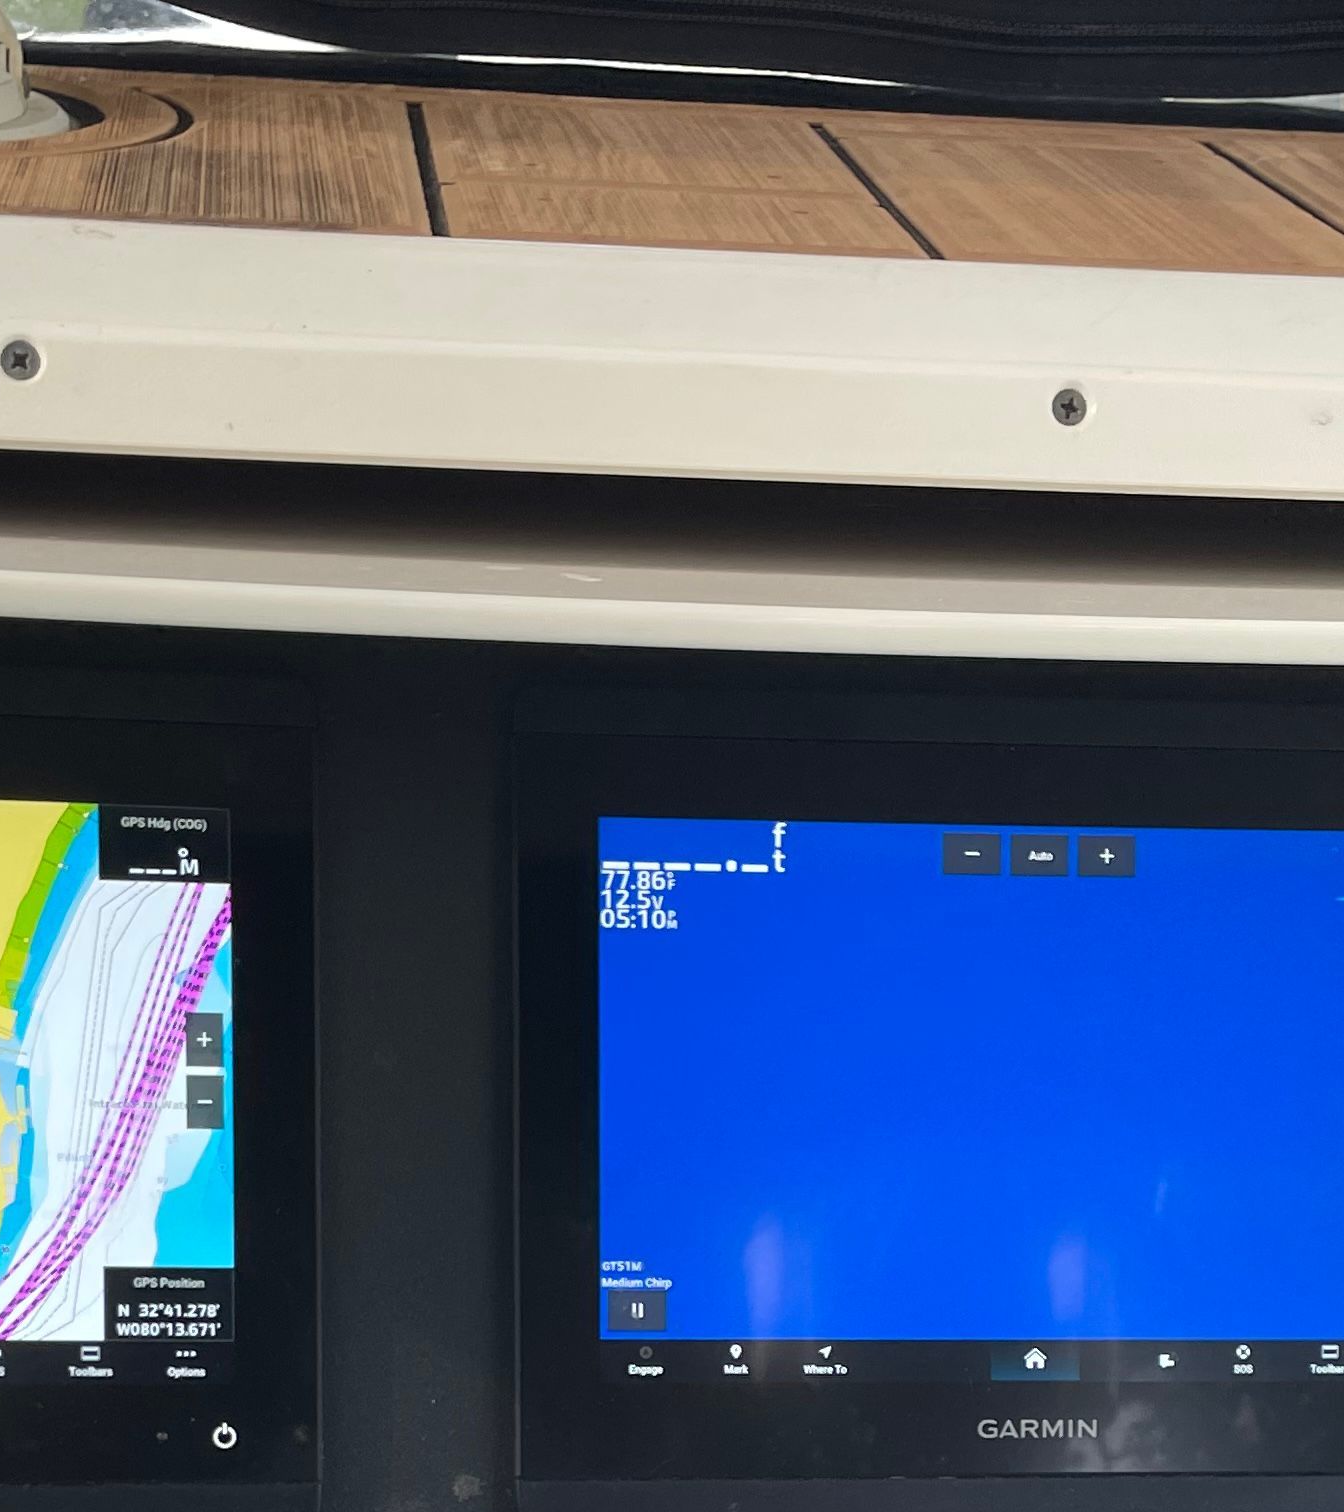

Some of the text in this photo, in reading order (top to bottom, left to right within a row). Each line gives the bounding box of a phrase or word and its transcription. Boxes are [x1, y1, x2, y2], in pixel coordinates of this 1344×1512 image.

[121, 816, 208, 832] GPS Hdg (COG)
[133, 1277, 206, 1289] GPS Position
[601, 1277, 673, 1291] Medium Chirp
[117, 1303, 130, 1318] N
[68, 1365, 114, 1378] Toolbars
[167, 1366, 207, 1380] Options
[628, 1364, 664, 1377] Engage
[723, 1364, 749, 1375] Mark
[803, 1364, 848, 1376] Where To
[1233, 1364, 1254, 1375] SOS
[976, 1419, 1098, 1440] GARMIN
